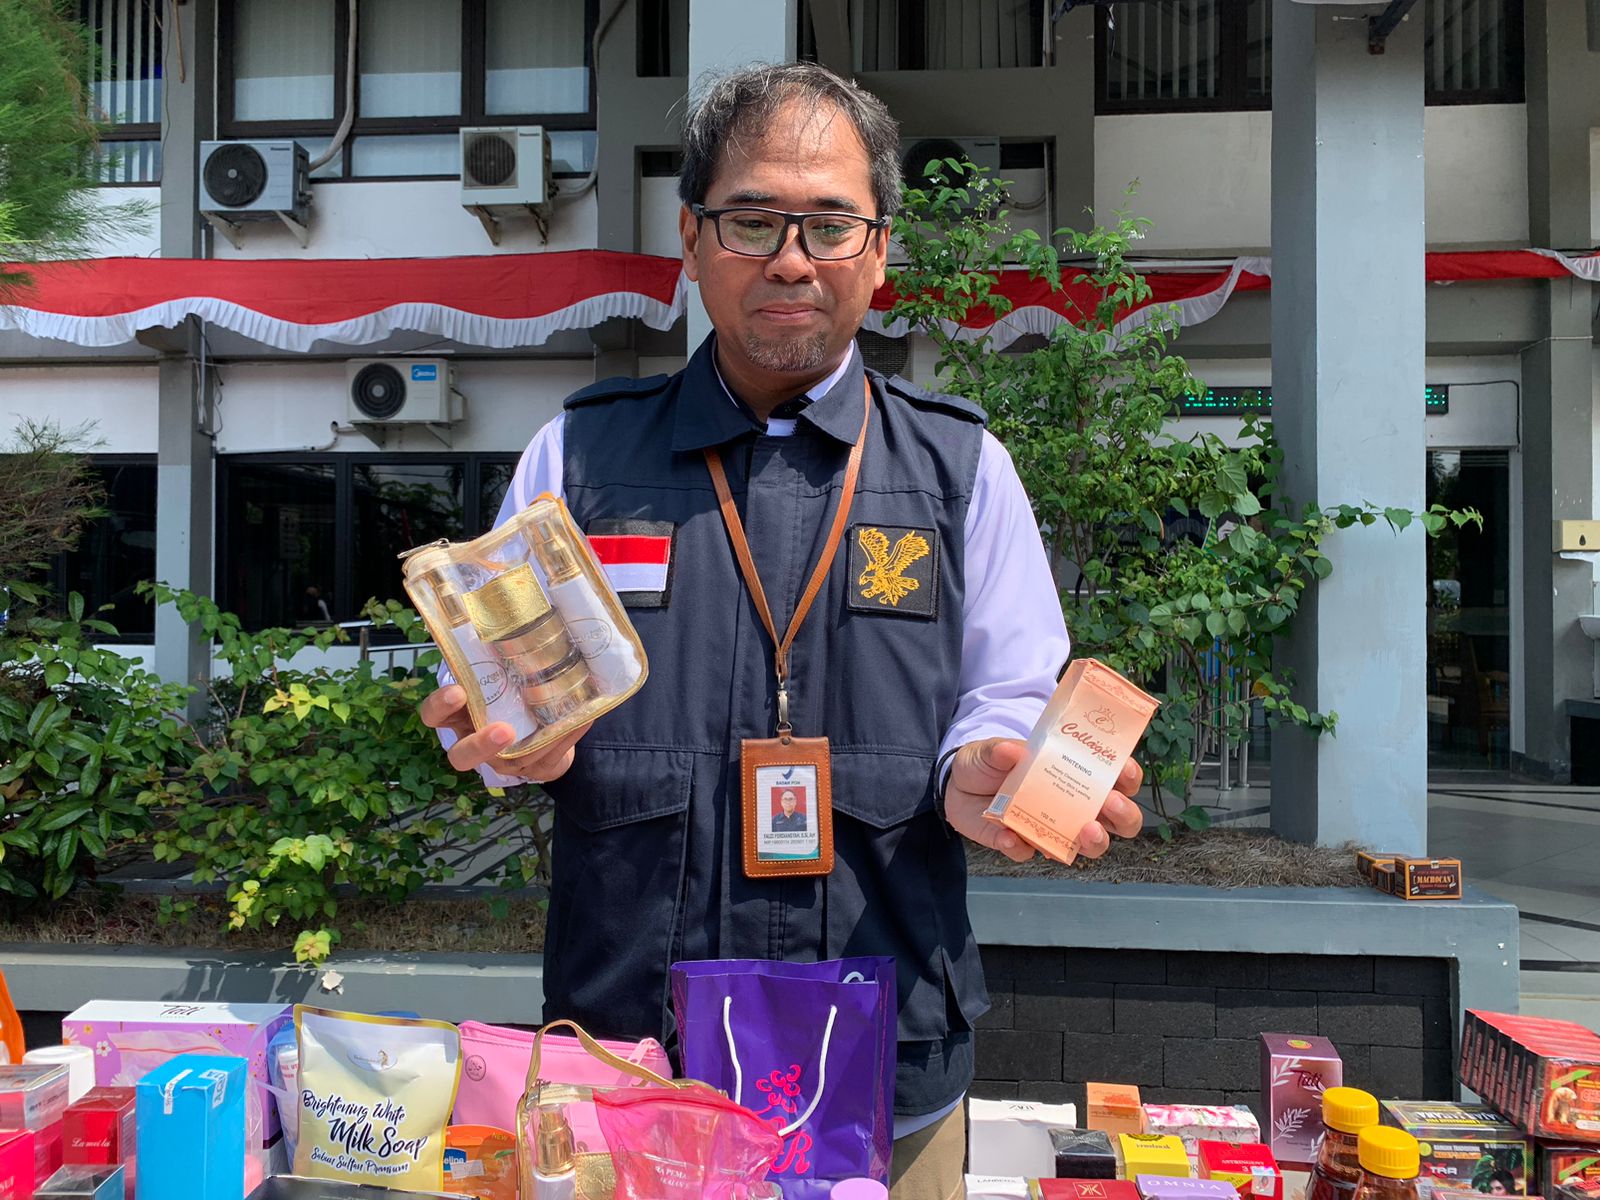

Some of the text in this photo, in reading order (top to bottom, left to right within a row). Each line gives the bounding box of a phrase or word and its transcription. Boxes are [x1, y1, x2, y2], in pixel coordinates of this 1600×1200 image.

[1061, 723, 1117, 762] Collagen
[1062, 754, 1092, 776] WHITENING
[302, 1090, 406, 1125] Brightening White
[328, 1118, 428, 1160] Milk Soap
[366, 1160, 409, 1175] Premium
[1147, 1180, 1221, 1190] OMNIA
